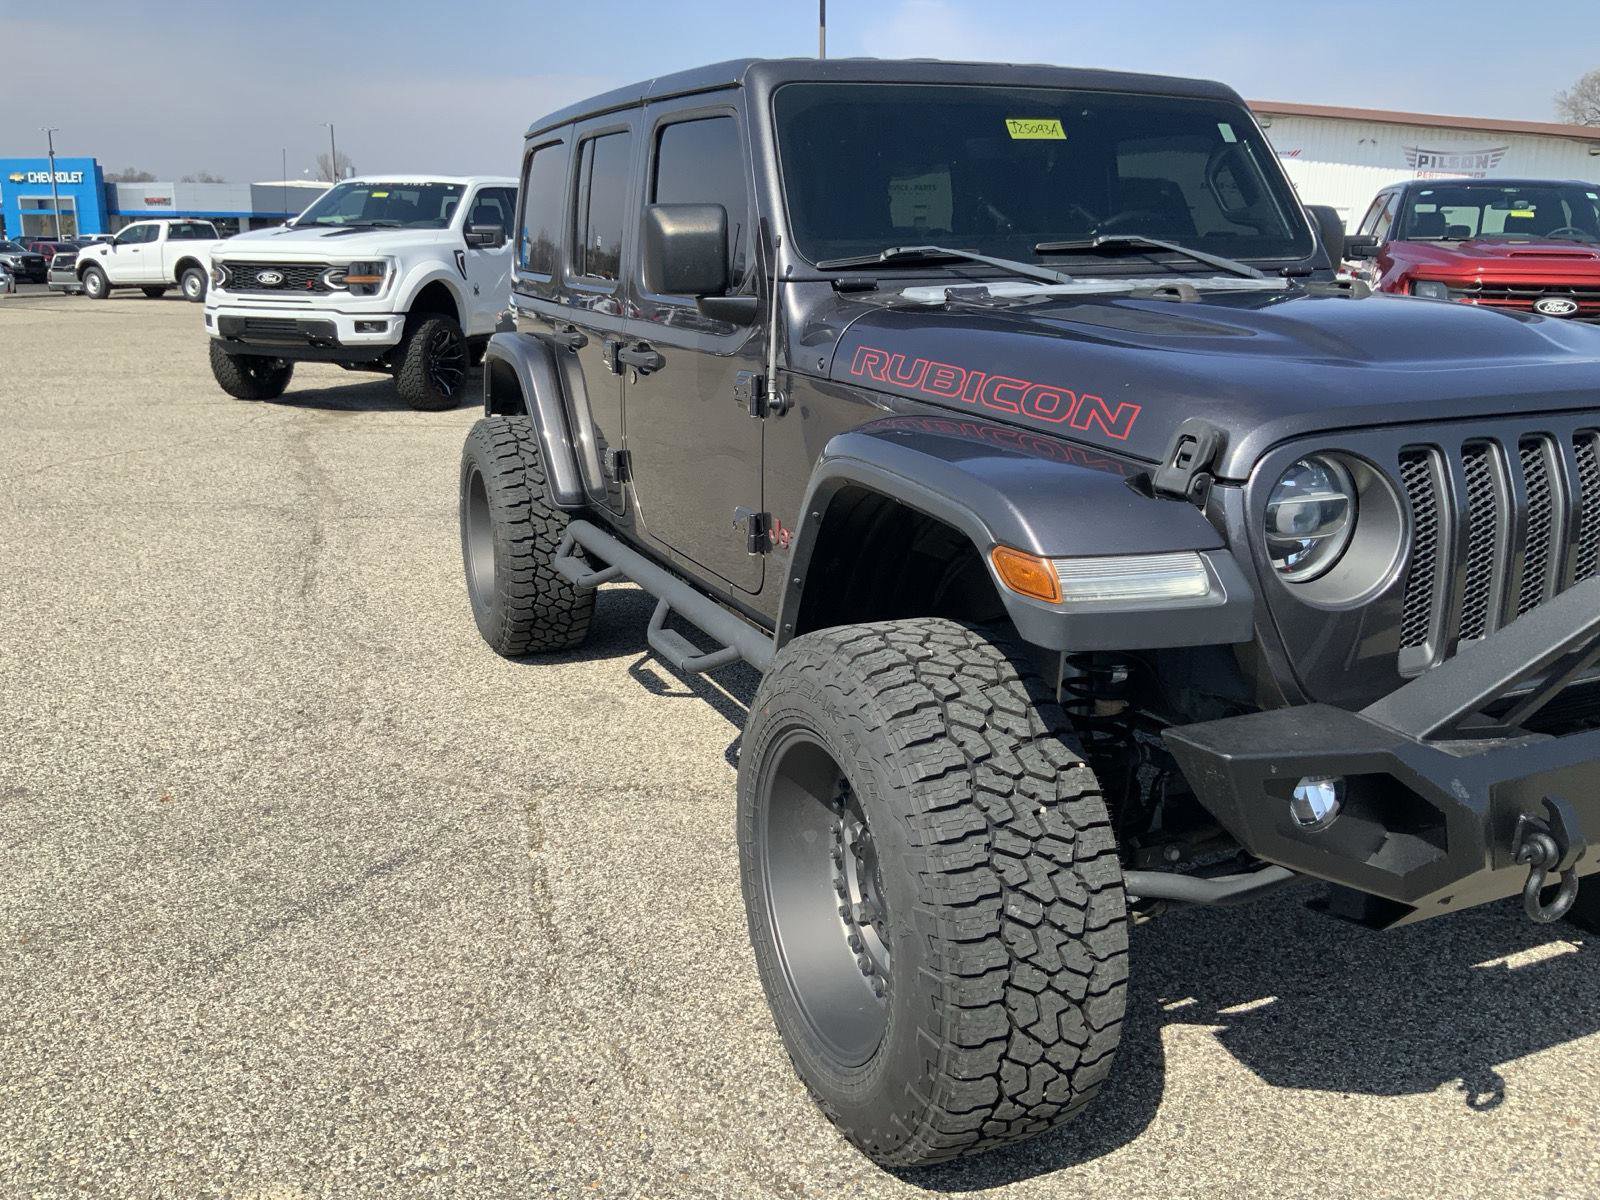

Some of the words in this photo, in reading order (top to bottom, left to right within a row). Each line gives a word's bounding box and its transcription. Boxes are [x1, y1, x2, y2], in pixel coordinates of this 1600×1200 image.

[1418, 154, 1489, 168] PILSON
[28, 171, 83, 183] CHEVROLET
[1542, 300, 1572, 313] Ford
[851, 346, 1142, 440] RUBICON
[769, 518, 790, 550] Je
